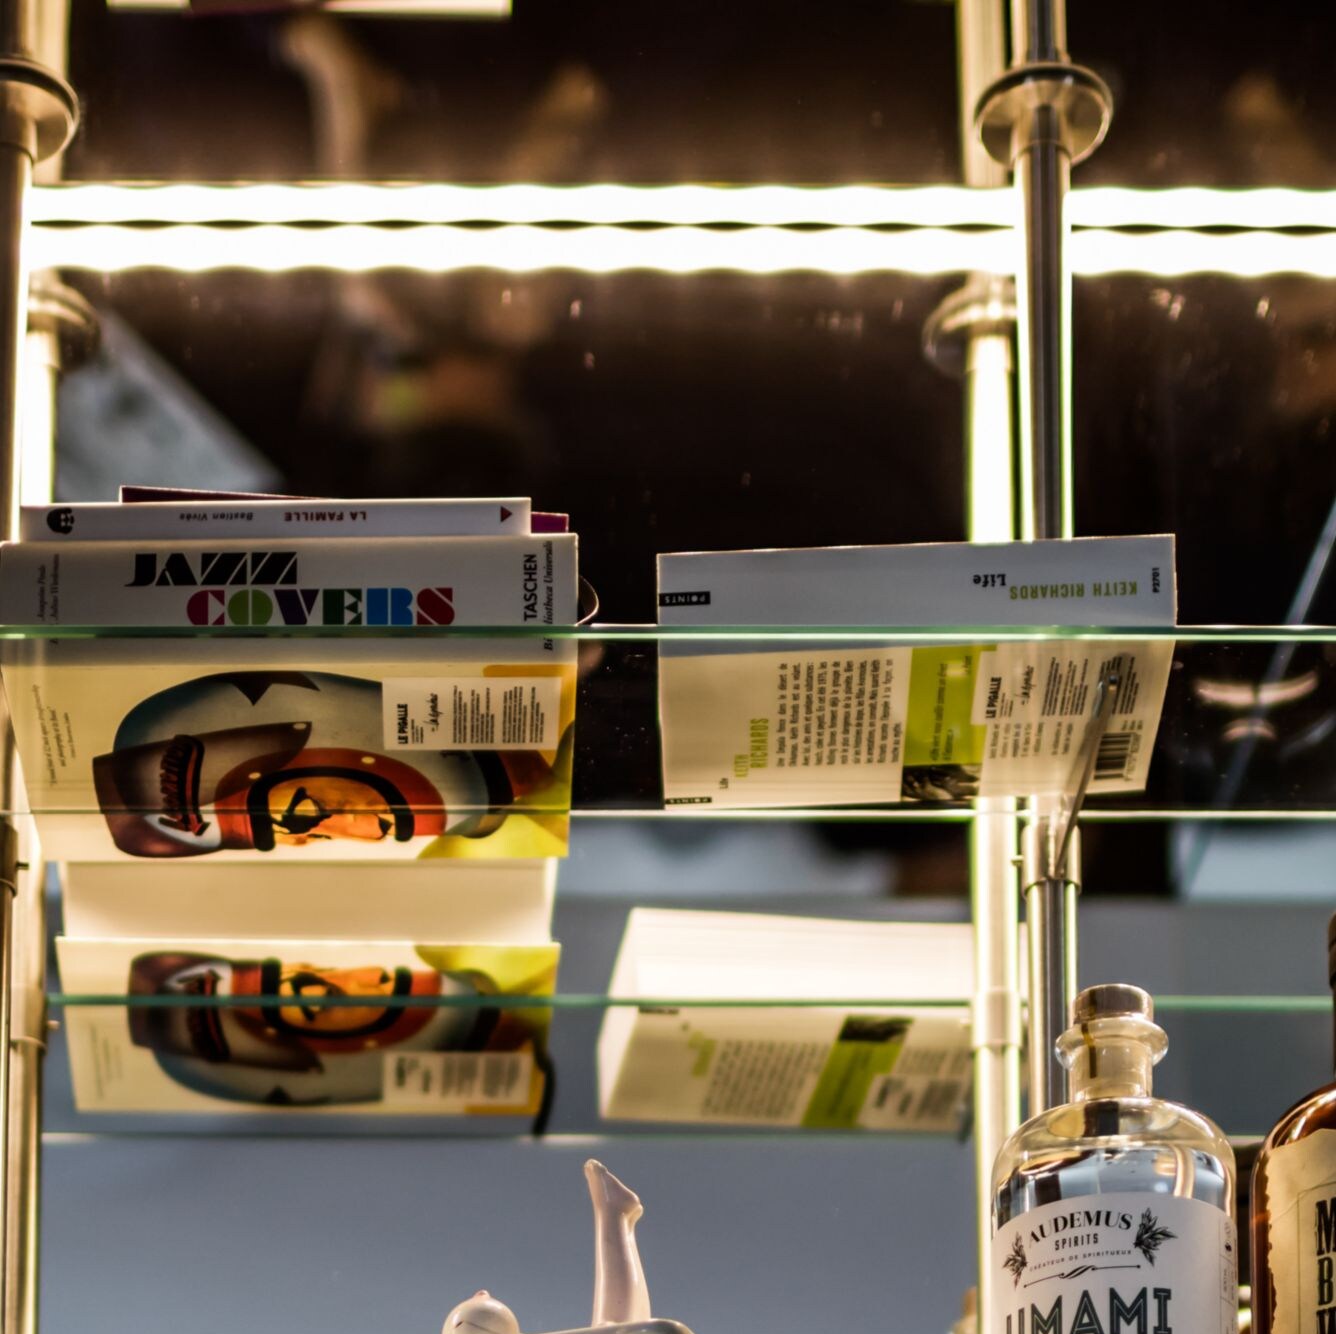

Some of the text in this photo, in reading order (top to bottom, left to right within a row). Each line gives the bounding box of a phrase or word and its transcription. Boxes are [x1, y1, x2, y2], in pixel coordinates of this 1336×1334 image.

[212, 512, 254, 522] Bastien
[284, 511, 367, 522] LA FAMILLE
[123, 551, 297, 587] JAZZ
[972, 573, 1007, 588] Life
[1151, 567, 1160, 593] P2701
[523, 553, 538, 621] TASCHEN
[665, 594, 706, 604] POINTS
[1009, 580, 1138, 600] KEITH RICHARDS
[186, 587, 455, 626] COVERS
[543, 586, 553, 651] Biliotheca
[985, 677, 1002, 718] LE PIGALLE
[397, 704, 408, 744] LE PIGALLE
[749, 718, 768, 768] RICHARDS
[734, 754, 748, 778] KEITH
[719, 777, 728, 789] Life
[1029, 1210, 1133, 1247] AUDEMUS
[1055, 1233, 1098, 1251] SPIRITS
[1083, 1249, 1132, 1259] SPIRITUEUX
